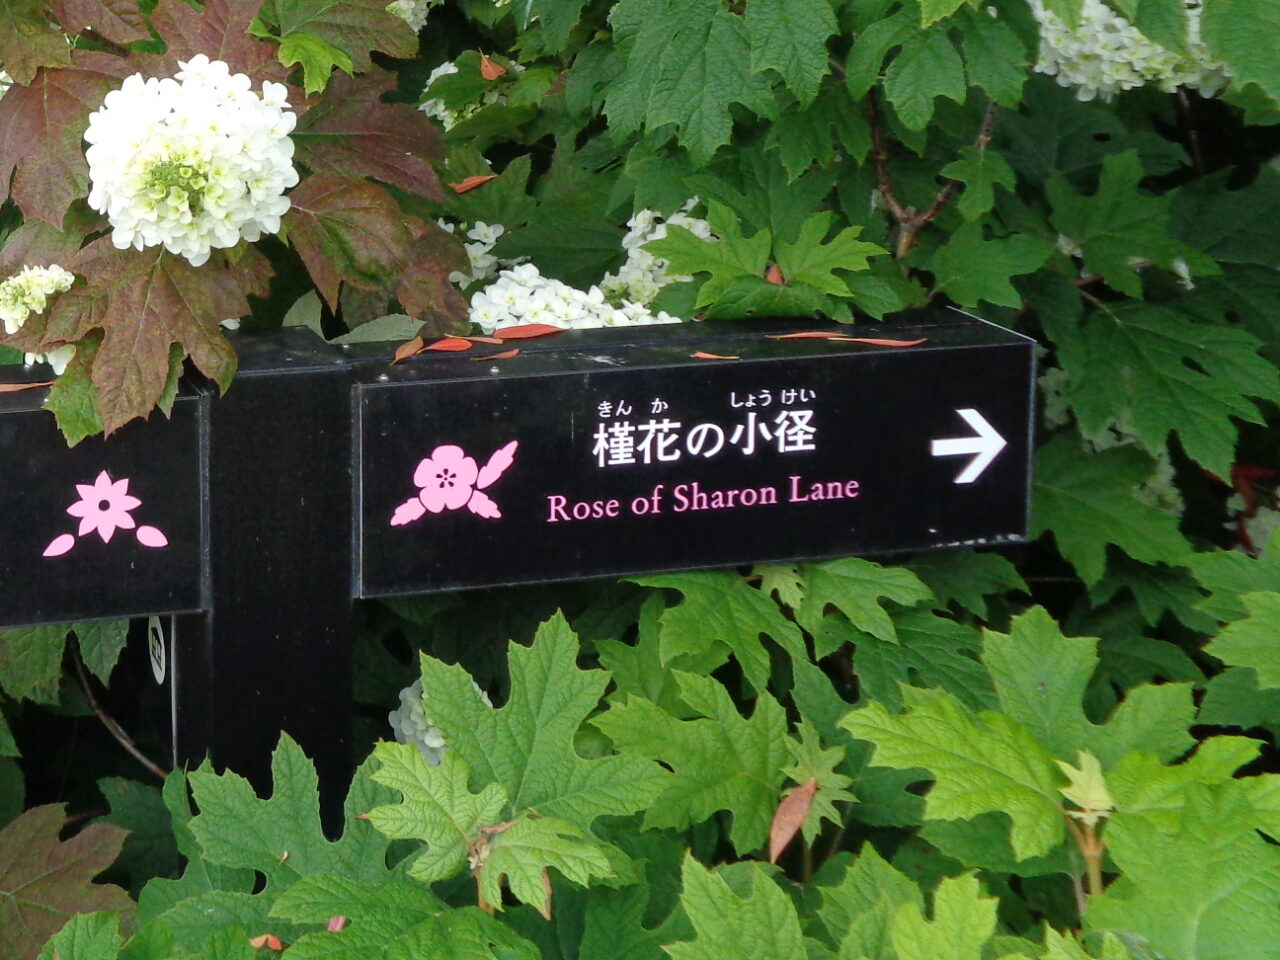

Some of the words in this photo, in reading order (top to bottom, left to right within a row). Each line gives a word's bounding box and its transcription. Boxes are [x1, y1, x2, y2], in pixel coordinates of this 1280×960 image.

[597, 400, 632, 418] きん
[651, 398, 669, 414] か
[592, 409, 817, 468] 槿花の小径
[547, 495, 620, 522] Rose
[631, 485, 663, 515] of
[673, 482, 778, 513] Sharon
[789, 476, 860, 503] Lane
